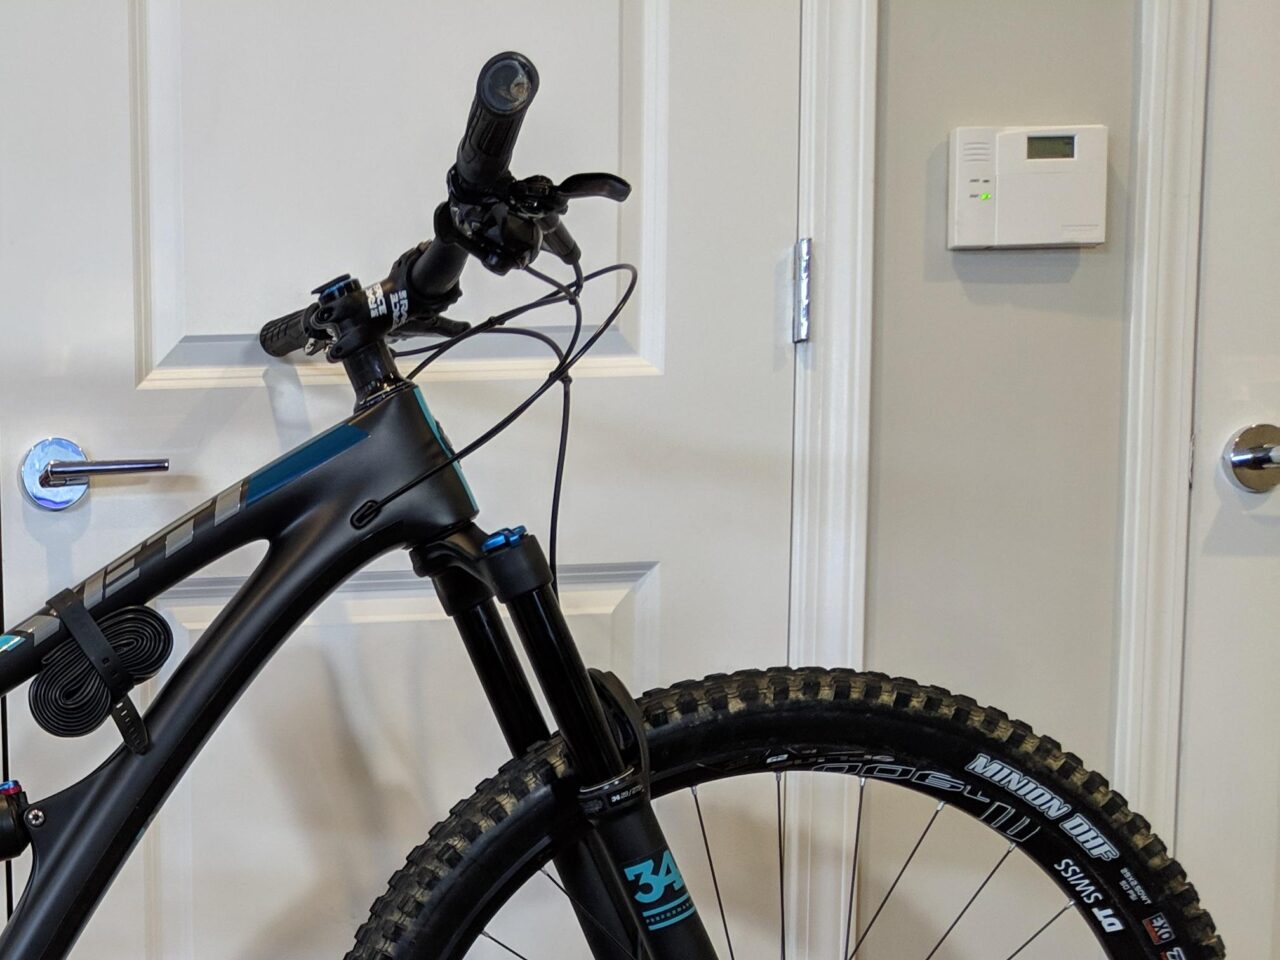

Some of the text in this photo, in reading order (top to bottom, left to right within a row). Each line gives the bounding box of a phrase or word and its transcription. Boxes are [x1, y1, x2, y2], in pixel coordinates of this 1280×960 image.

[964, 753, 1121, 861] MINION DHF
[624, 850, 687, 903] 34
[1053, 858, 1124, 934] DT SWISS
[1152, 915, 1175, 942] EXO
